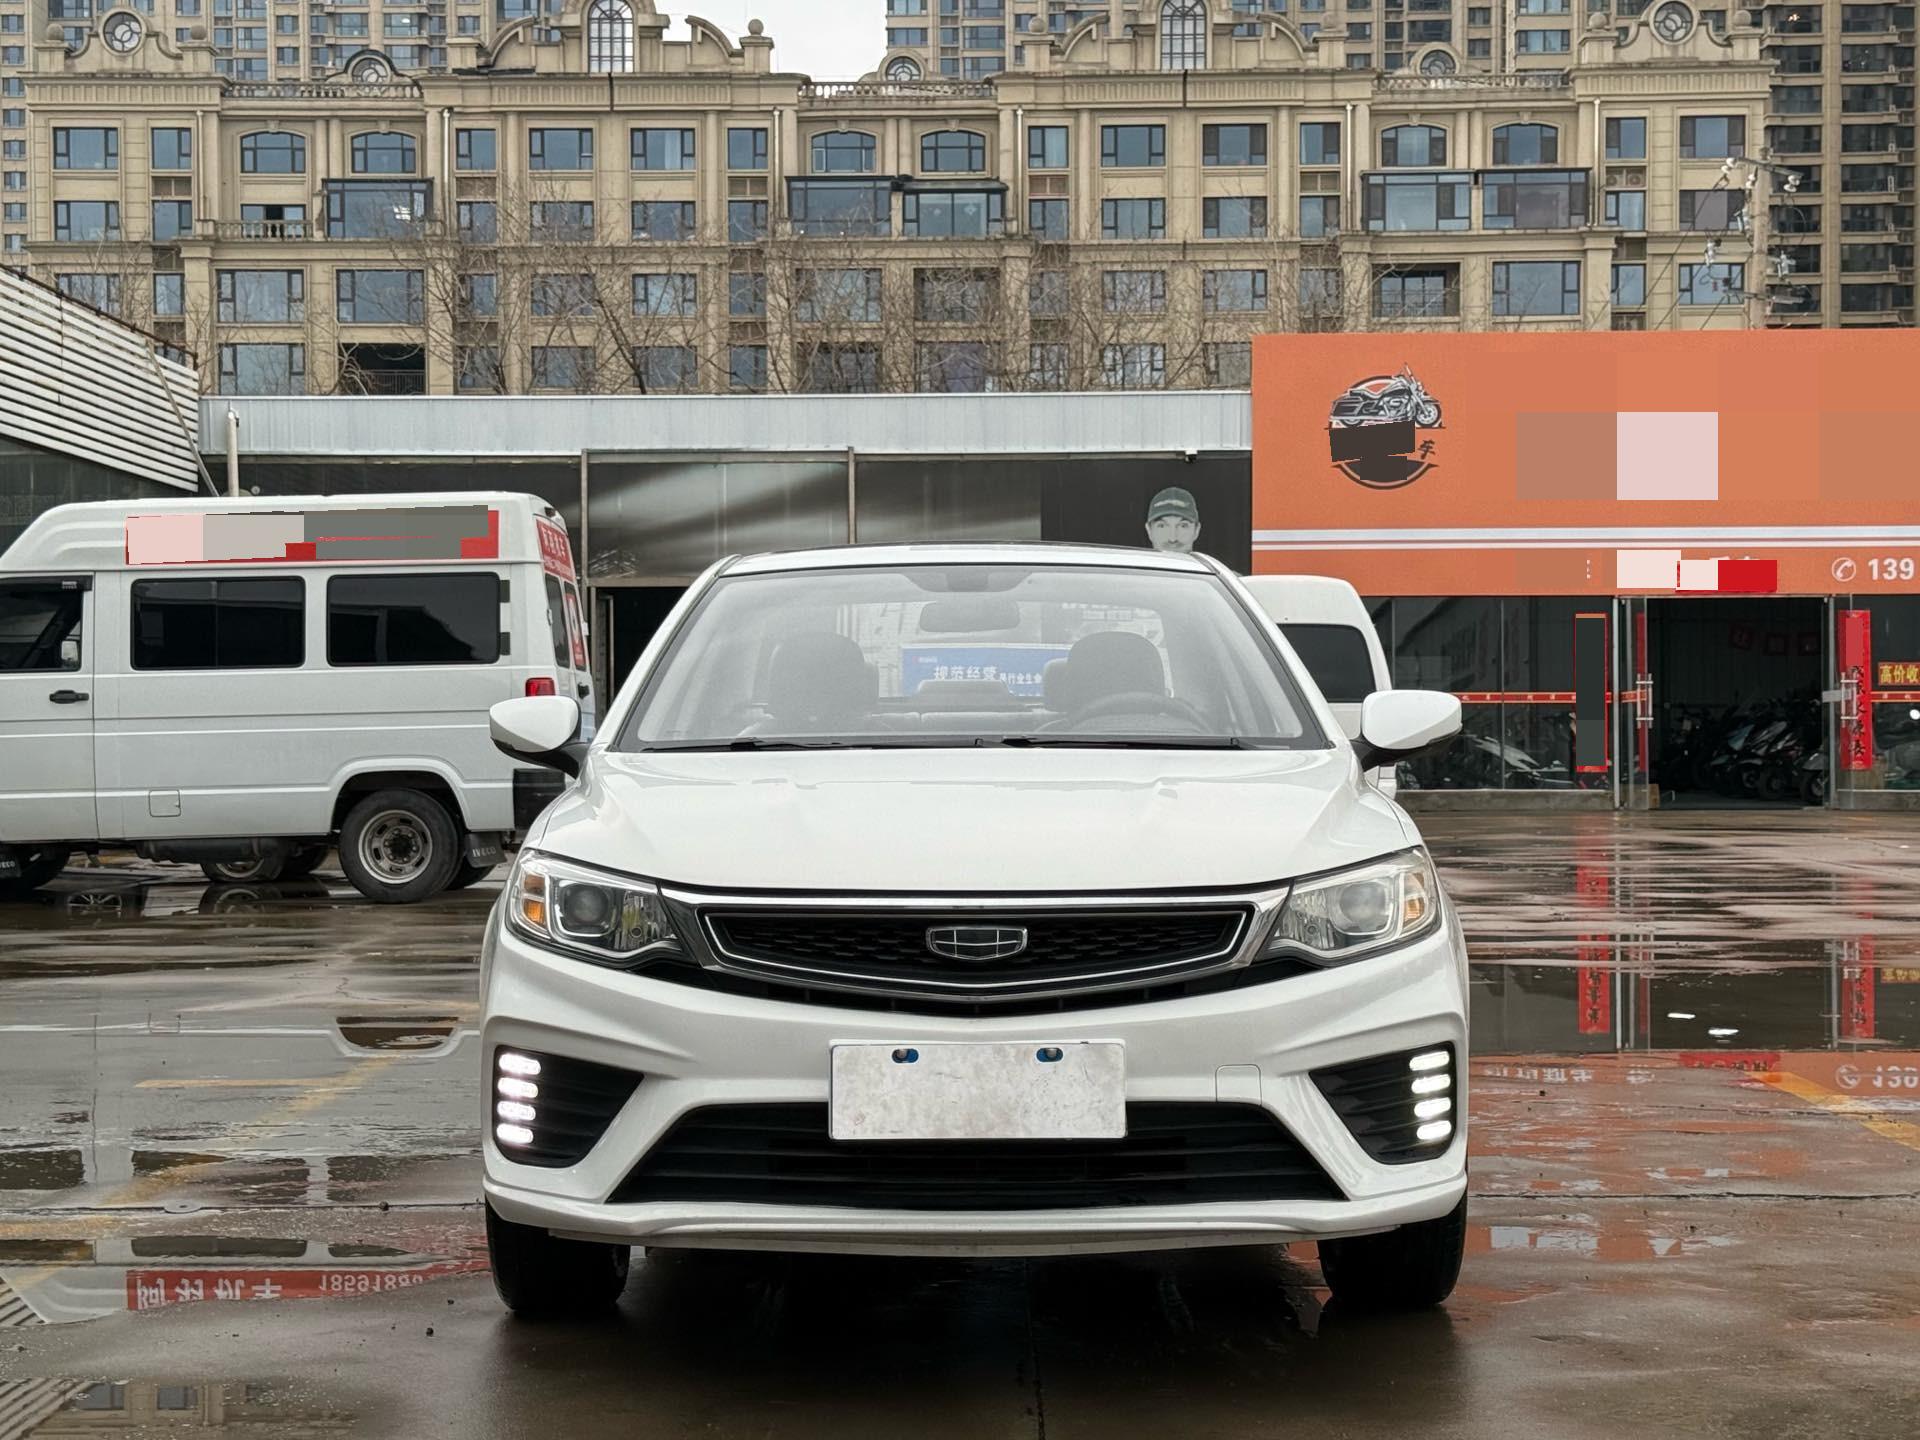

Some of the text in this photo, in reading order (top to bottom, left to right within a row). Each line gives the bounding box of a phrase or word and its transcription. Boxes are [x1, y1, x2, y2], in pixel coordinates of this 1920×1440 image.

[1869, 558, 1914, 580] 139
[1880, 664, 1919, 684] 高价收
